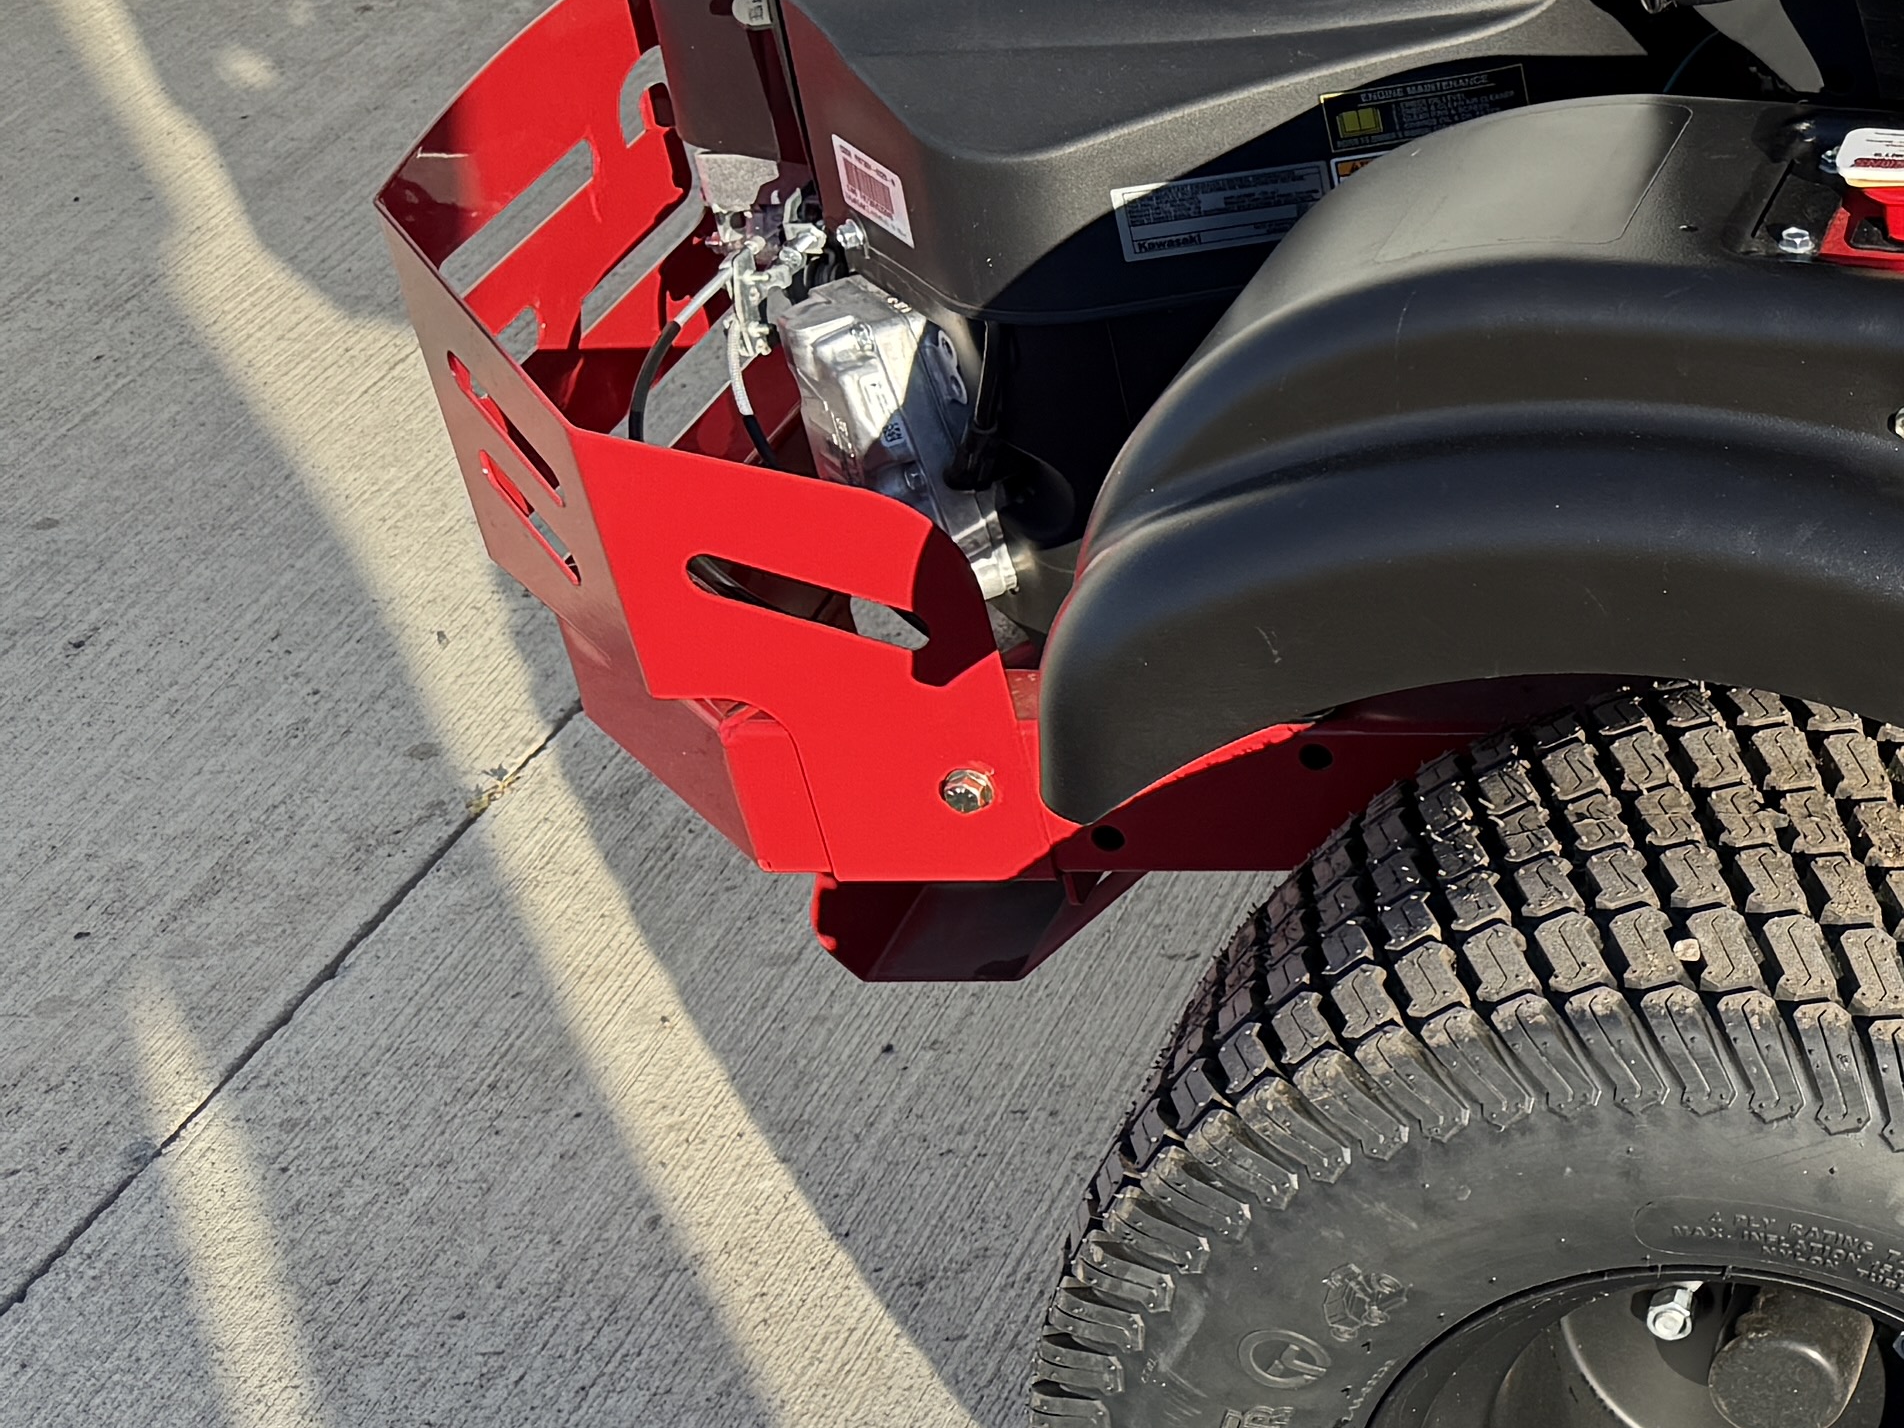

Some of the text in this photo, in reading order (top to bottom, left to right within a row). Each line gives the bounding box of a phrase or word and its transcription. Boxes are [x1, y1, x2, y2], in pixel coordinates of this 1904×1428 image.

[1360, 74, 1490, 103] ENGINE MAINTENANCE
[1138, 235, 1201, 253] Kawasaki
[1672, 1225, 1733, 1239] MAX.
[1742, 1231, 1861, 1264] INFLATION
[1734, 1214, 1776, 1229] PLY
[1788, 1223, 1874, 1252] RATING
[1762, 1244, 1839, 1268] NYLON
